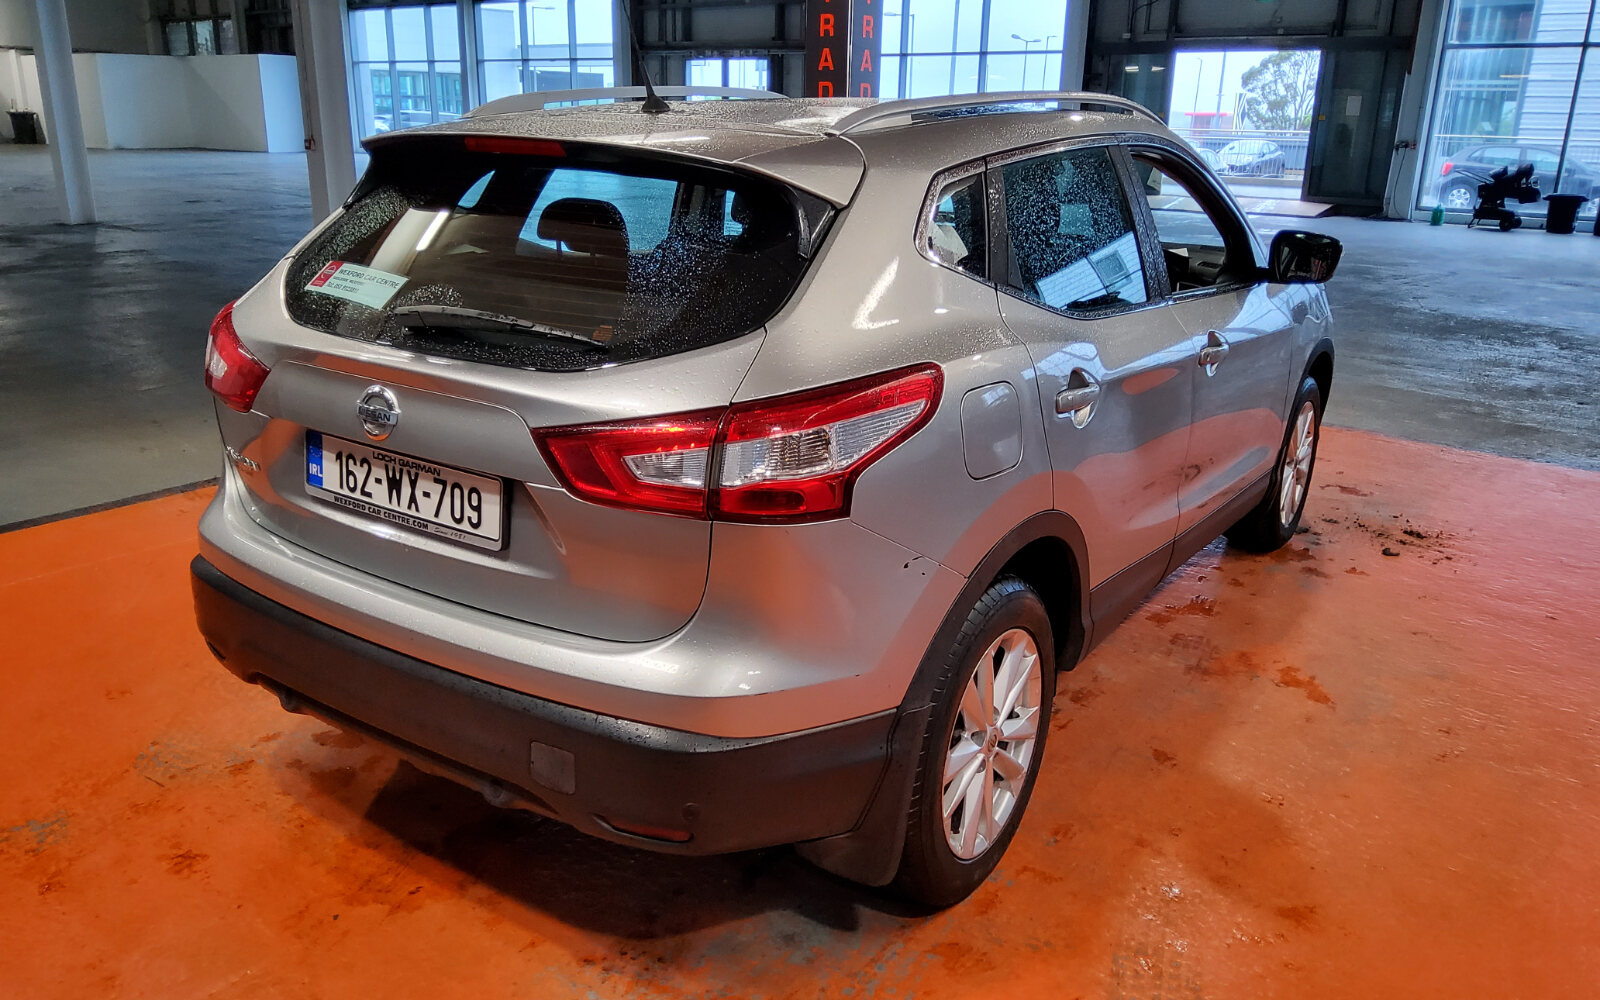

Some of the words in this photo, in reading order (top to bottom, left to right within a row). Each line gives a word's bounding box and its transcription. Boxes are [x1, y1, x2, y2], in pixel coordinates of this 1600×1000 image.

[818, 0, 835, 98] RAD
[860, 0, 874, 98] RAD
[338, 269, 365, 279] WEXFORD
[376, 277, 400, 289] CENTRE
[359, 406, 391, 422] NISSAN
[309, 463, 323, 478] IRL
[372, 451, 397, 465] LOCH
[398, 456, 441, 477] GARMAN
[335, 450, 482, 530] 162-WX-709
[333, 495, 366, 511] WEXFORD
[367, 506, 382, 516] CAR
[383, 511, 429, 531] CENTRE.COM
